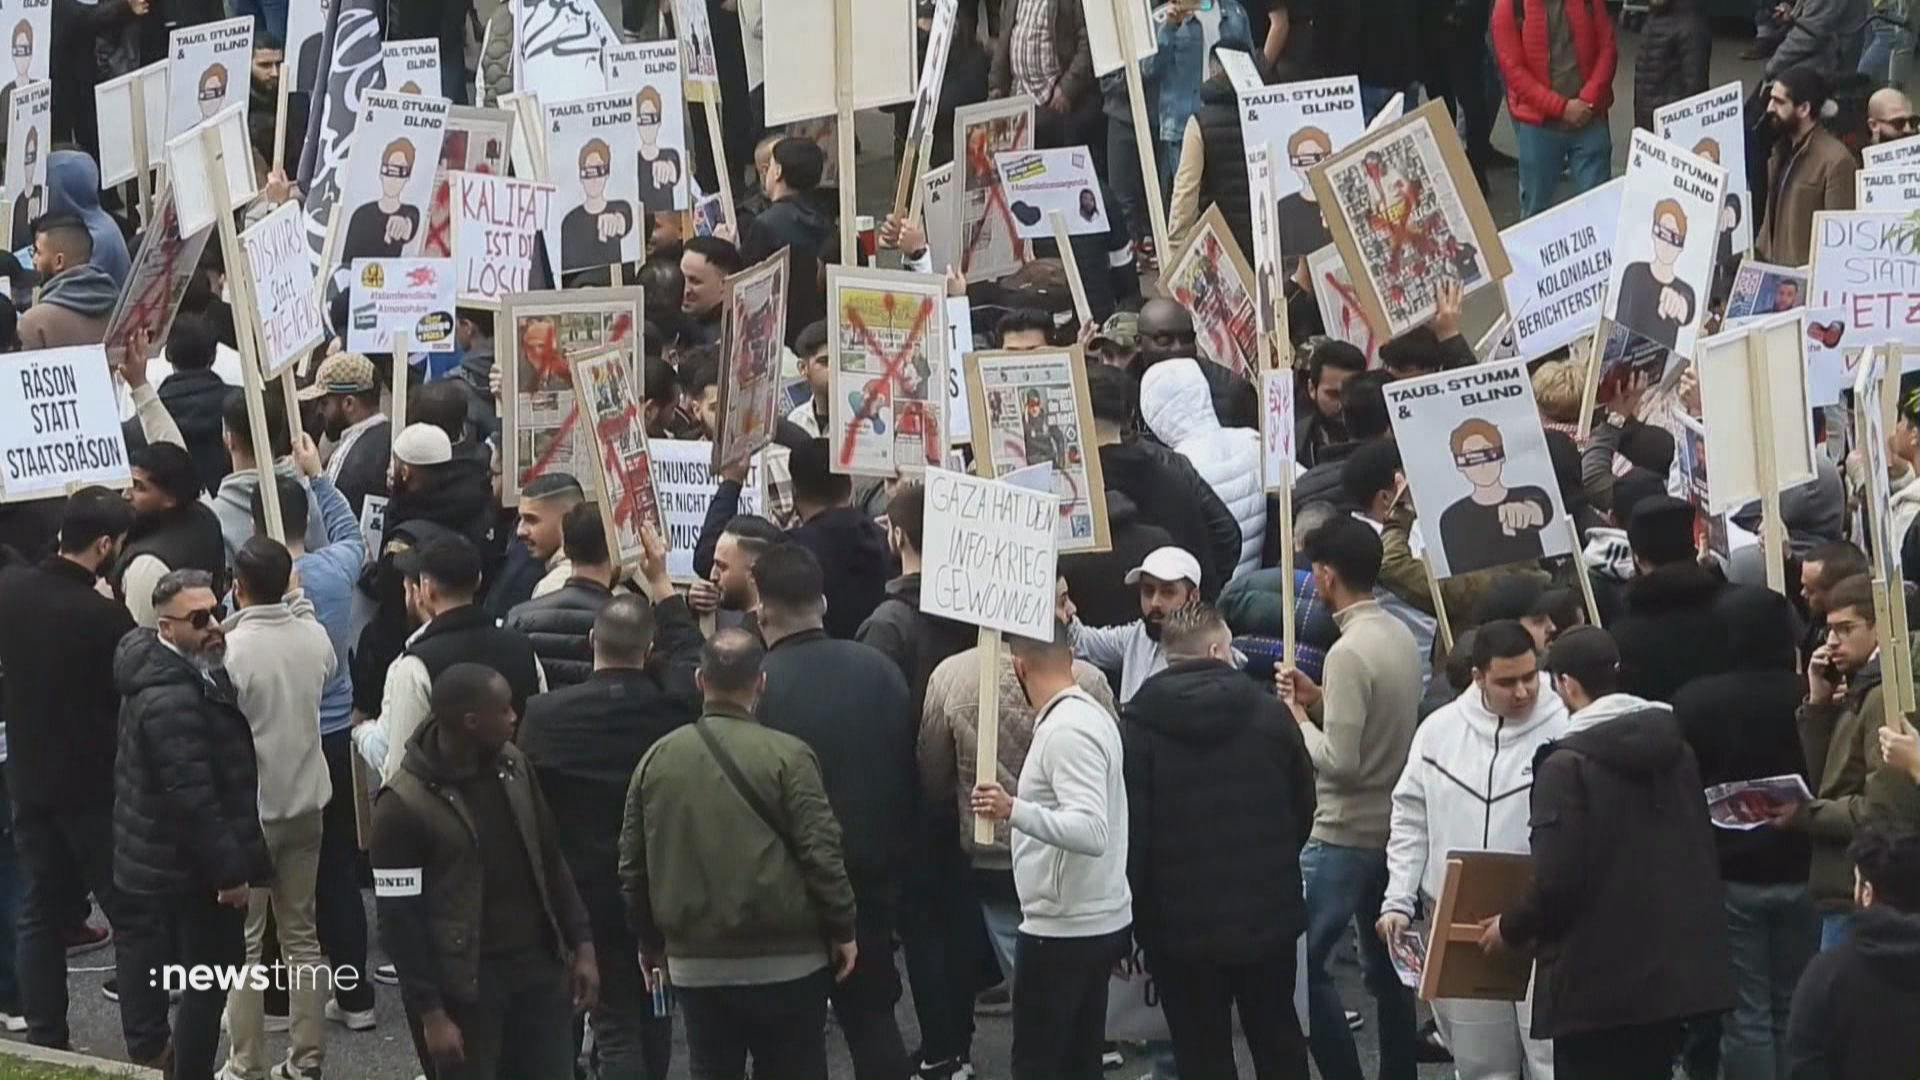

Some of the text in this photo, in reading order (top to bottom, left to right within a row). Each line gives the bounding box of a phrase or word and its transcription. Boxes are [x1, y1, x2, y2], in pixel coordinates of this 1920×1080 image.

[177, 49, 185, 60] &
[407, 58, 437, 71] BLIND
[402, 100, 446, 114] STUMM
[587, 97, 633, 113] STUMM
[1293, 85, 1354, 101] STUMM
[366, 110, 442, 129] & BLIND
[552, 112, 632, 132] & BLIND
[1248, 100, 1354, 121] & BLIND
[1664, 107, 1738, 140] & BLIND
[1633, 157, 1715, 203] & BLIND
[1671, 157, 1718, 188] STUMM
[462, 177, 556, 231] KALIFAT
[932, 192, 940, 203] &
[485, 231, 537, 261] IST DI
[1539, 226, 1597, 268] NEIN ZUR
[467, 256, 528, 297] LÖSU
[1537, 249, 1612, 300] KOLONIALEN
[20, 363, 78, 400] RÄSON
[1447, 367, 1520, 392] STUMM
[31, 400, 80, 434] STATT
[1398, 385, 1523, 419] & BLIND
[7, 435, 122, 479] STAATSRÄSON
[676, 493, 707, 513] NICHT
[931, 477, 1055, 532] GAZA HAT DEN
[370, 518, 382, 530] &
[671, 524, 704, 550] MUS
[949, 527, 1047, 588] INFO-KRIEG
[935, 565, 1047, 627] GEWONNEN
